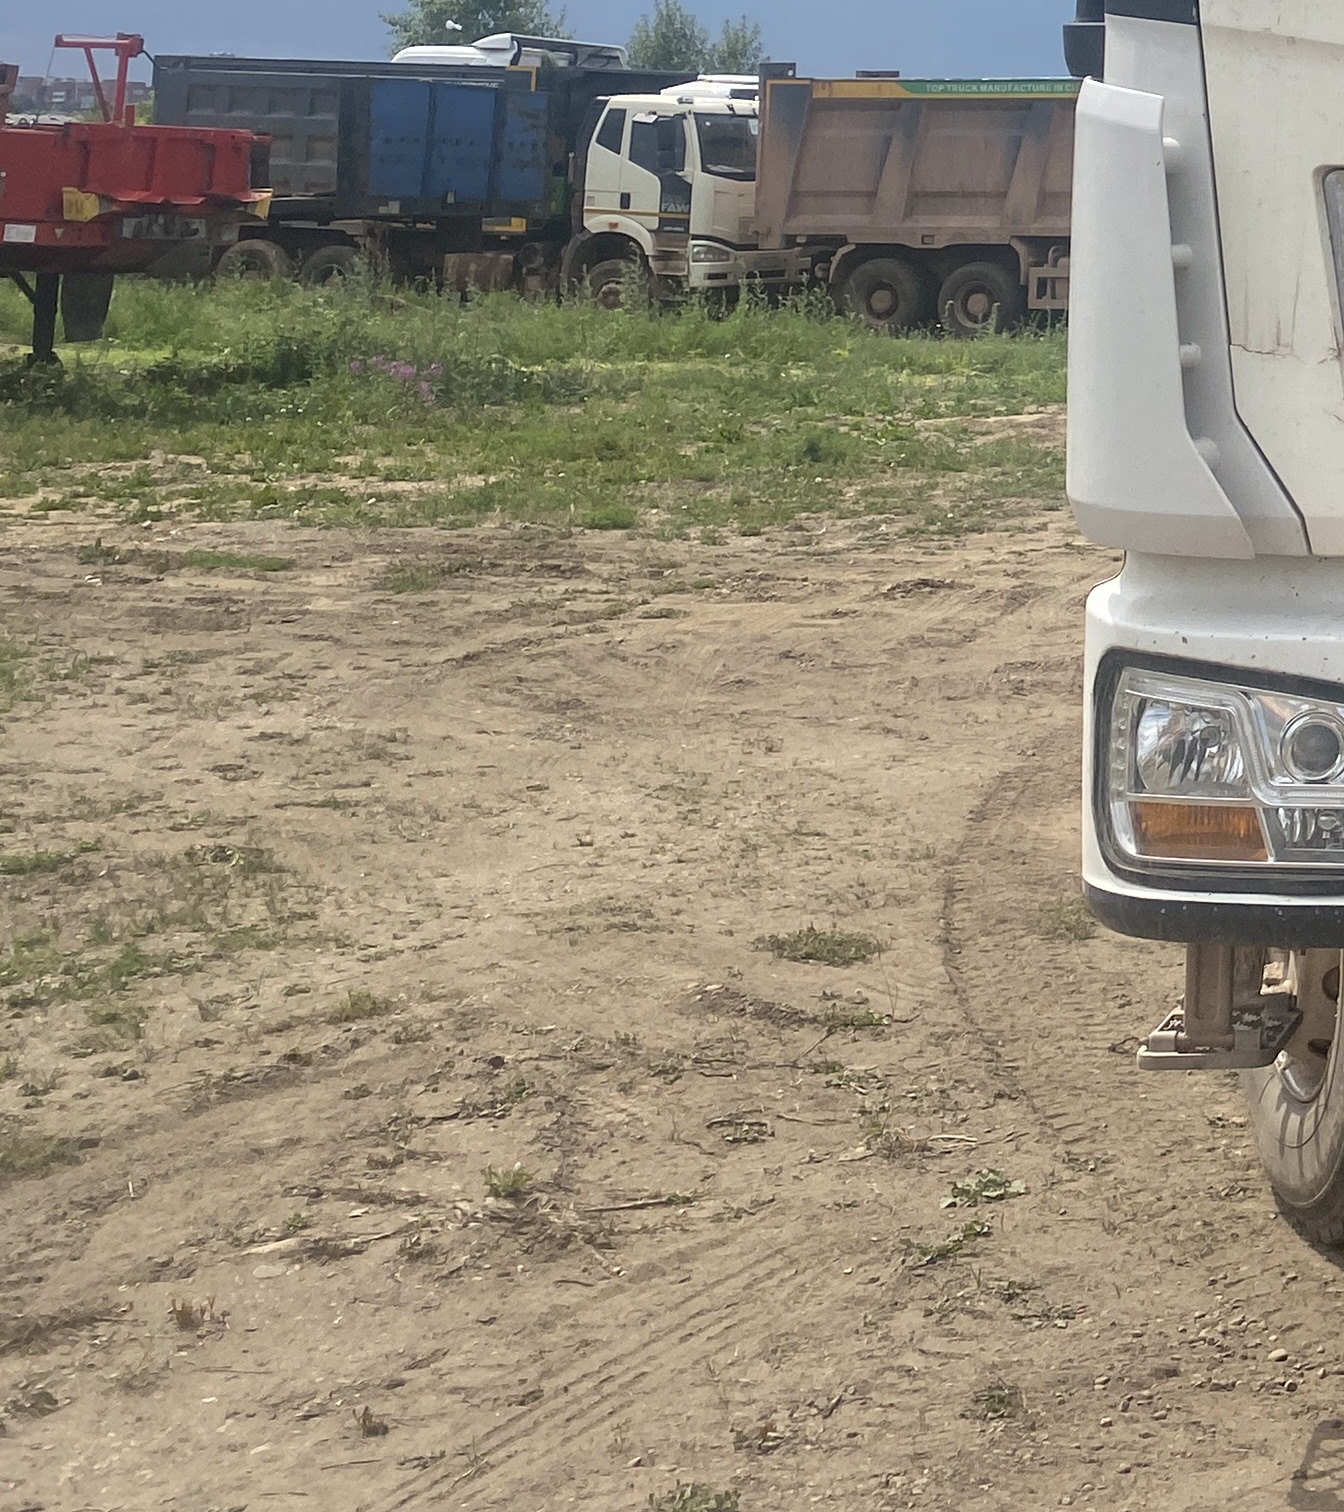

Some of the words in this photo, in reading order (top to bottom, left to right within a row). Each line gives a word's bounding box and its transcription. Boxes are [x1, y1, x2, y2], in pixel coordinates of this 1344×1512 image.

[926, 84, 943, 93] TOP
[945, 84, 978, 93] TRUCK
[980, 83, 1051, 92] MANUFACTURE
[1053, 83, 1064, 92] IN
[661, 202, 690, 213] FAW
